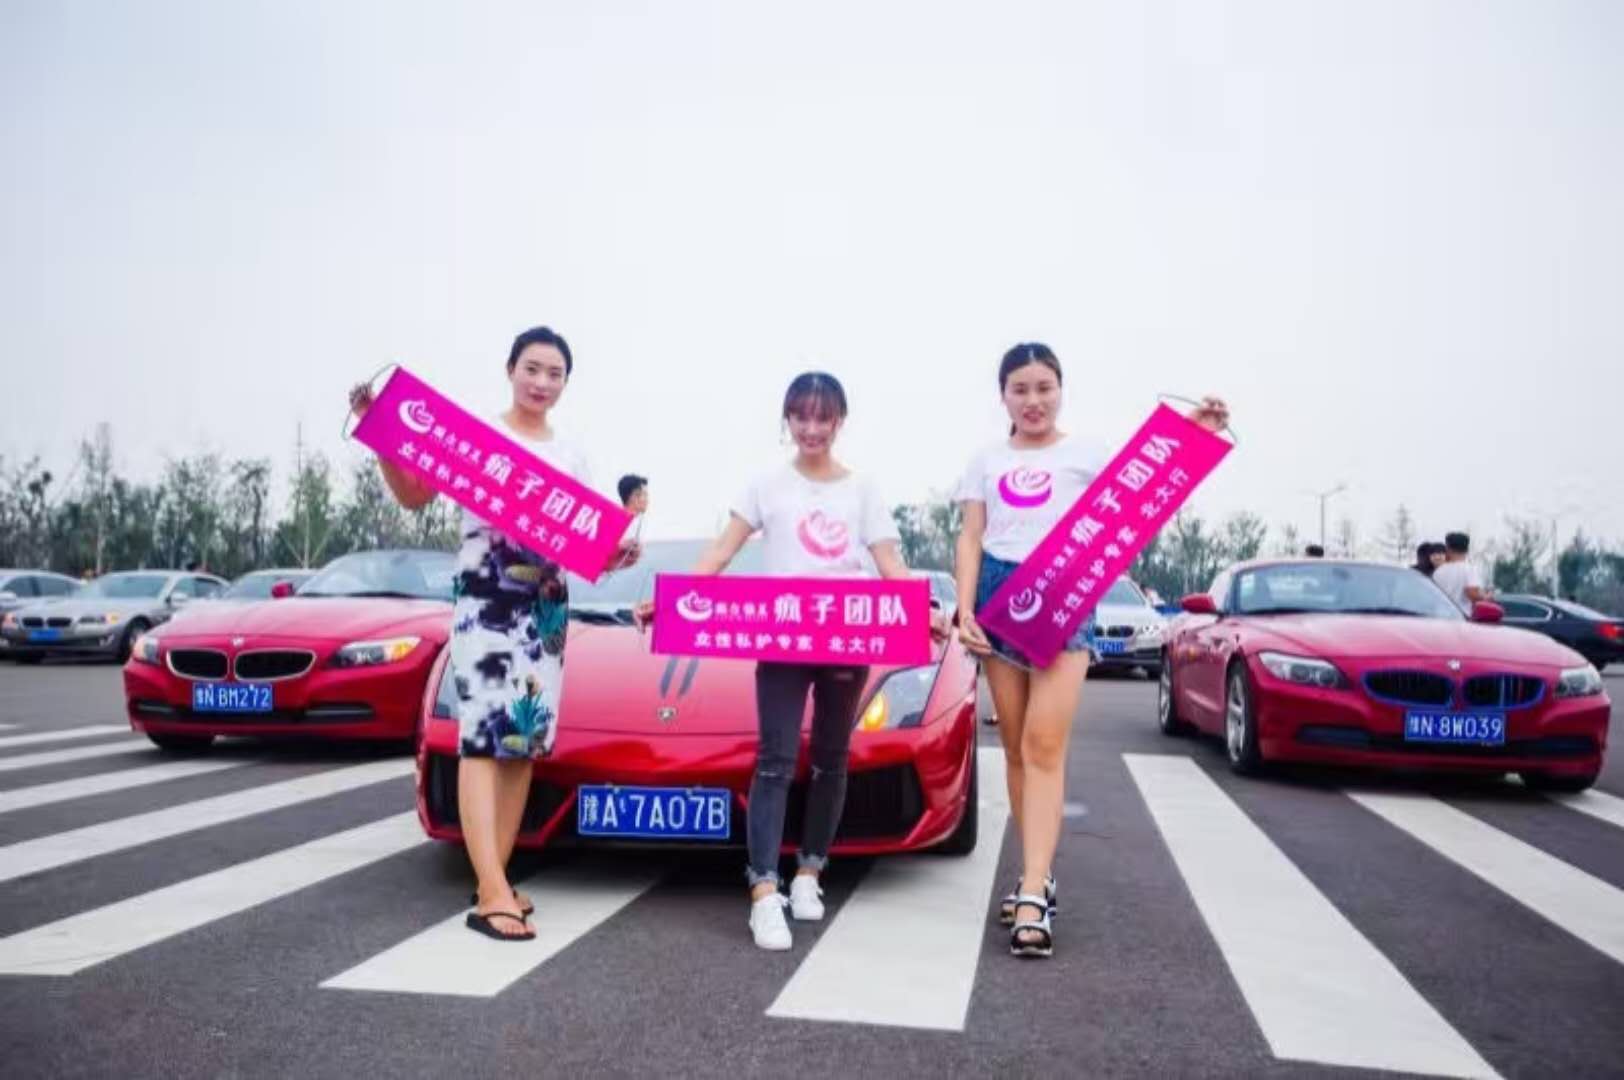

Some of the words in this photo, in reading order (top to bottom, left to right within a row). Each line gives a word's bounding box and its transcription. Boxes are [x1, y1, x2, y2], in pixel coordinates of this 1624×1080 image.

[397, 440, 507, 516] 女性私护专家
[514, 515, 570, 554] 北大行
[481, 451, 604, 542] 疯子团队
[1070, 433, 1182, 549] 疯子团队
[1051, 525, 1139, 629] 女性私护专家
[1140, 466, 1191, 519] 北大行
[694, 631, 813, 651] 女性私护专家
[828, 635, 888, 655] 北大行
[773, 593, 909, 627] 疯子团队
